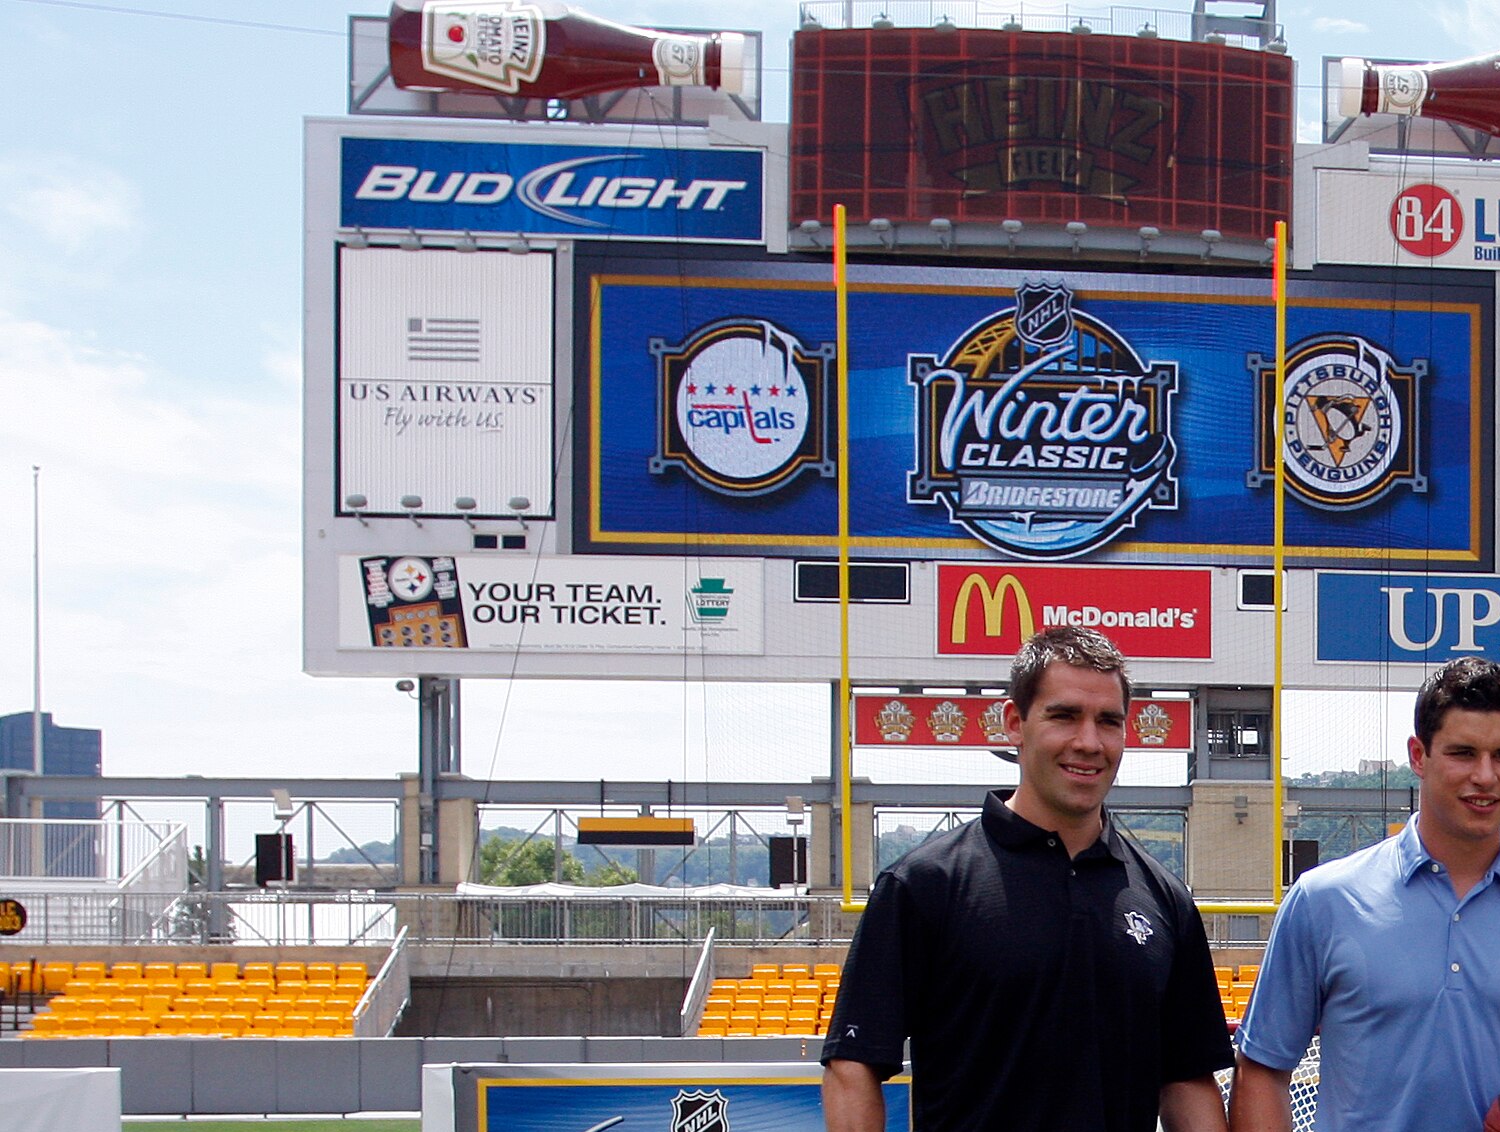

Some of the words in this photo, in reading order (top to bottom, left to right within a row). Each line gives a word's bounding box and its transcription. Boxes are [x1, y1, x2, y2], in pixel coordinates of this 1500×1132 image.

[488, 13, 502, 65] OMATO
[1397, 75, 1409, 95] 57
[923, 77, 1173, 165] HEINZ
[1011, 152, 1080, 179] FIELD
[355, 165, 513, 204] BUD
[543, 172, 747, 211] LIGHT
[1397, 195, 1455, 243] 84
[1027, 300, 1062, 333] NHL
[400, 384, 536, 404] AIRWAYS
[924, 346, 1149, 470] Winter
[1285, 367, 1391, 430] PITTSBURGH
[384, 406, 413, 436] Fly
[418, 408, 468, 428] with
[687, 392, 796, 440] capitals
[960, 442, 1128, 470] CLASSIC
[1288, 441, 1389, 480] PENGUINS
[963, 481, 1122, 508] BRIDGESTONE
[467, 583, 556, 602] YOUR
[566, 584, 662, 603] TEAM.
[473, 604, 540, 624] OUR
[550, 605, 666, 625] TICKET.
[1043, 605, 1195, 628] McDonald's
